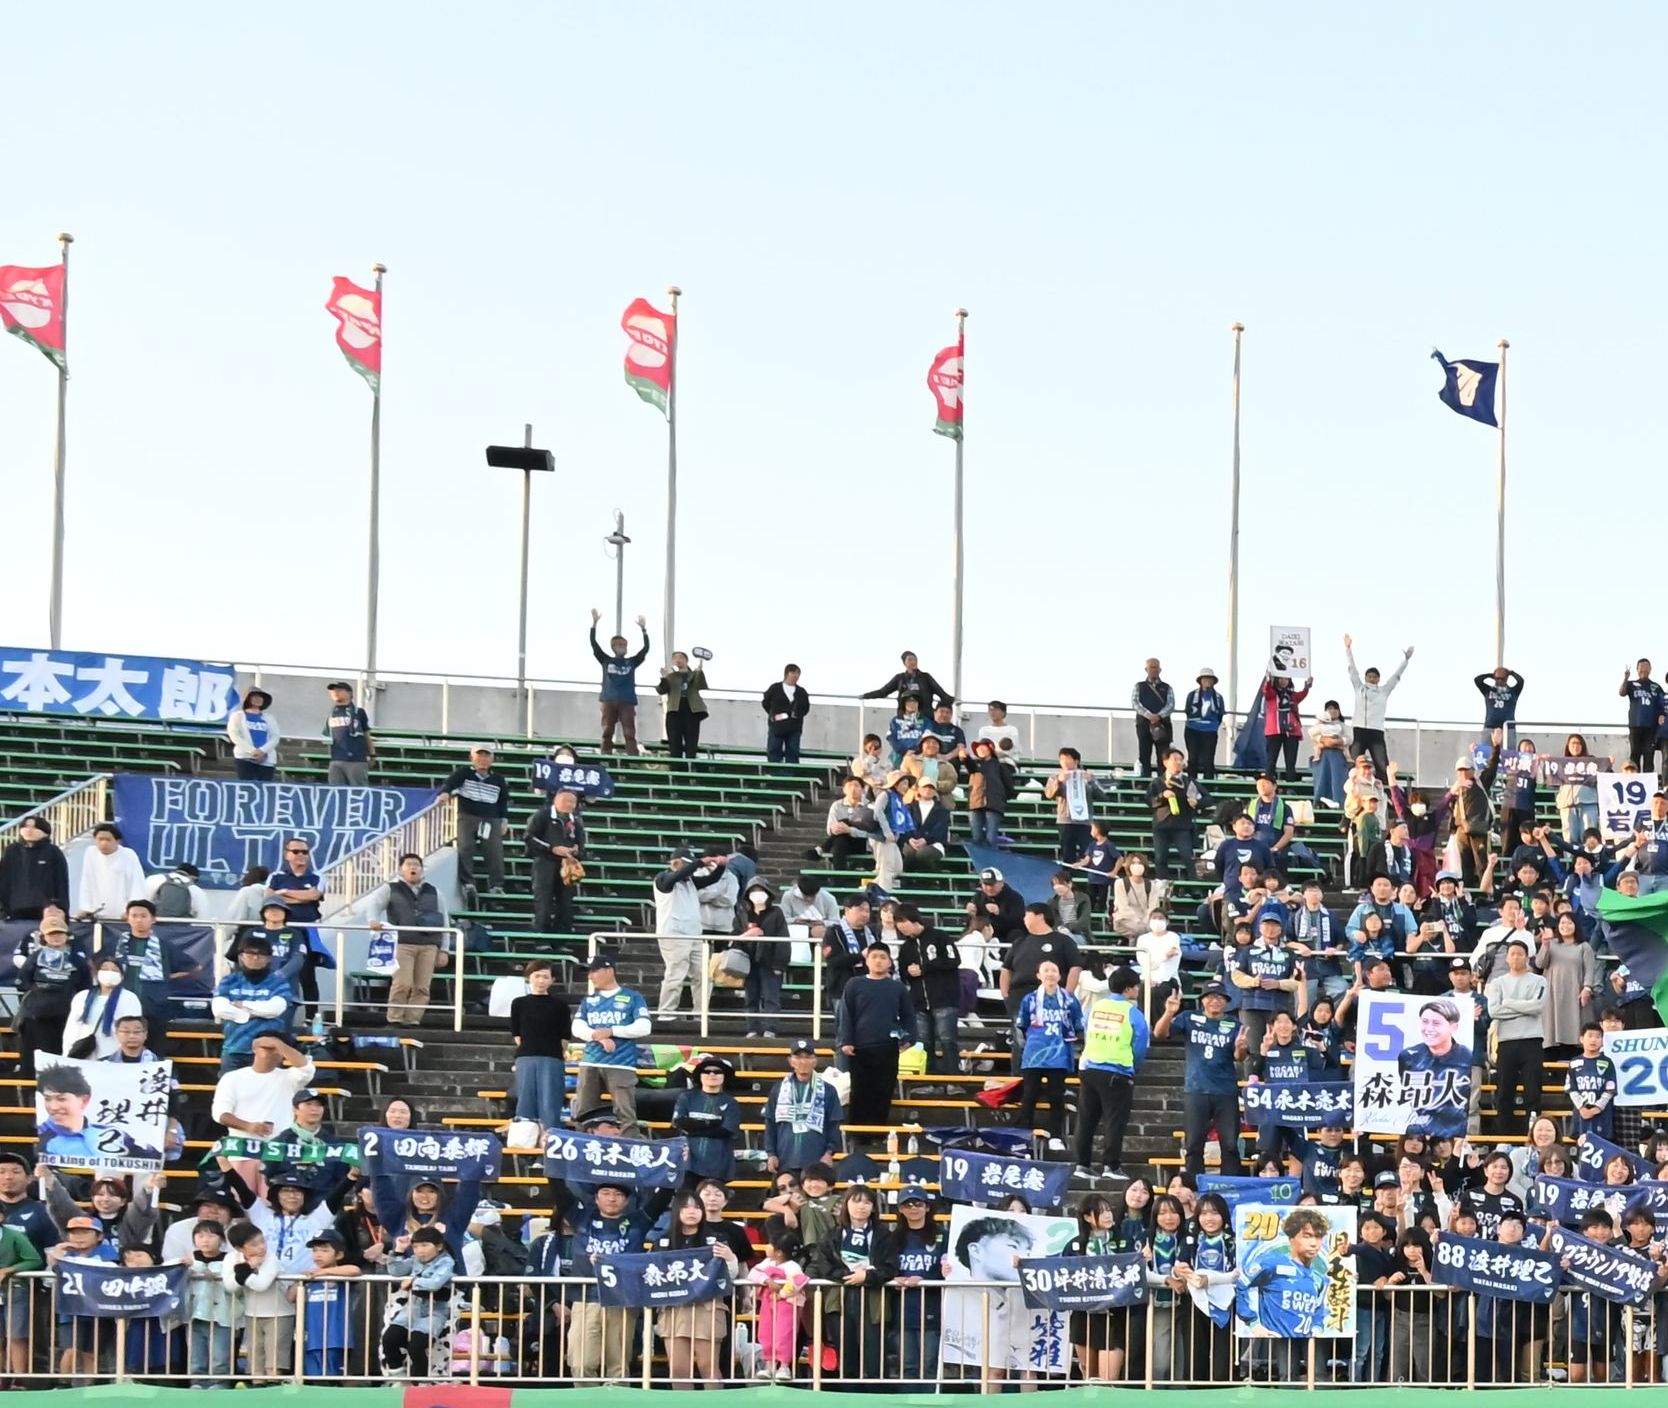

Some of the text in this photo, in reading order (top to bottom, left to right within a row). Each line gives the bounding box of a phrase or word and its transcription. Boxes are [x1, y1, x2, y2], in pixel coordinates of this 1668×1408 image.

[2, 652, 228, 721] 本太郎
[536, 764, 552, 778] 19
[151, 778, 406, 833] FOREVER
[1612, 781, 1647, 805] 19
[1365, 1002, 1406, 1061] 5
[1204, 1046, 1213, 1059] 8
[1246, 1087, 1272, 1109] 54
[1356, 1070, 1471, 1111] 森昂大
[364, 1132, 378, 1157] 2
[547, 1135, 577, 1160] 26
[1580, 1145, 1602, 1168] 26
[61, 1156, 101, 1168] king of
[945, 1157, 968, 1181] 19
[1538, 1181, 1560, 1206] 19
[1242, 1212, 1280, 1240] 20
[1552, 1233, 1564, 1249] 9
[1437, 1242, 1465, 1268] 88
[62, 1272, 86, 1297] 21
[601, 1260, 709, 1288] 5 森昂大
[1022, 1264, 1141, 1293] 30 坪井清志郎
[1472, 1277, 1493, 1288] WATAI
[1582, 1293, 1591, 1308] 9
[1294, 1313, 1312, 1334] 20
